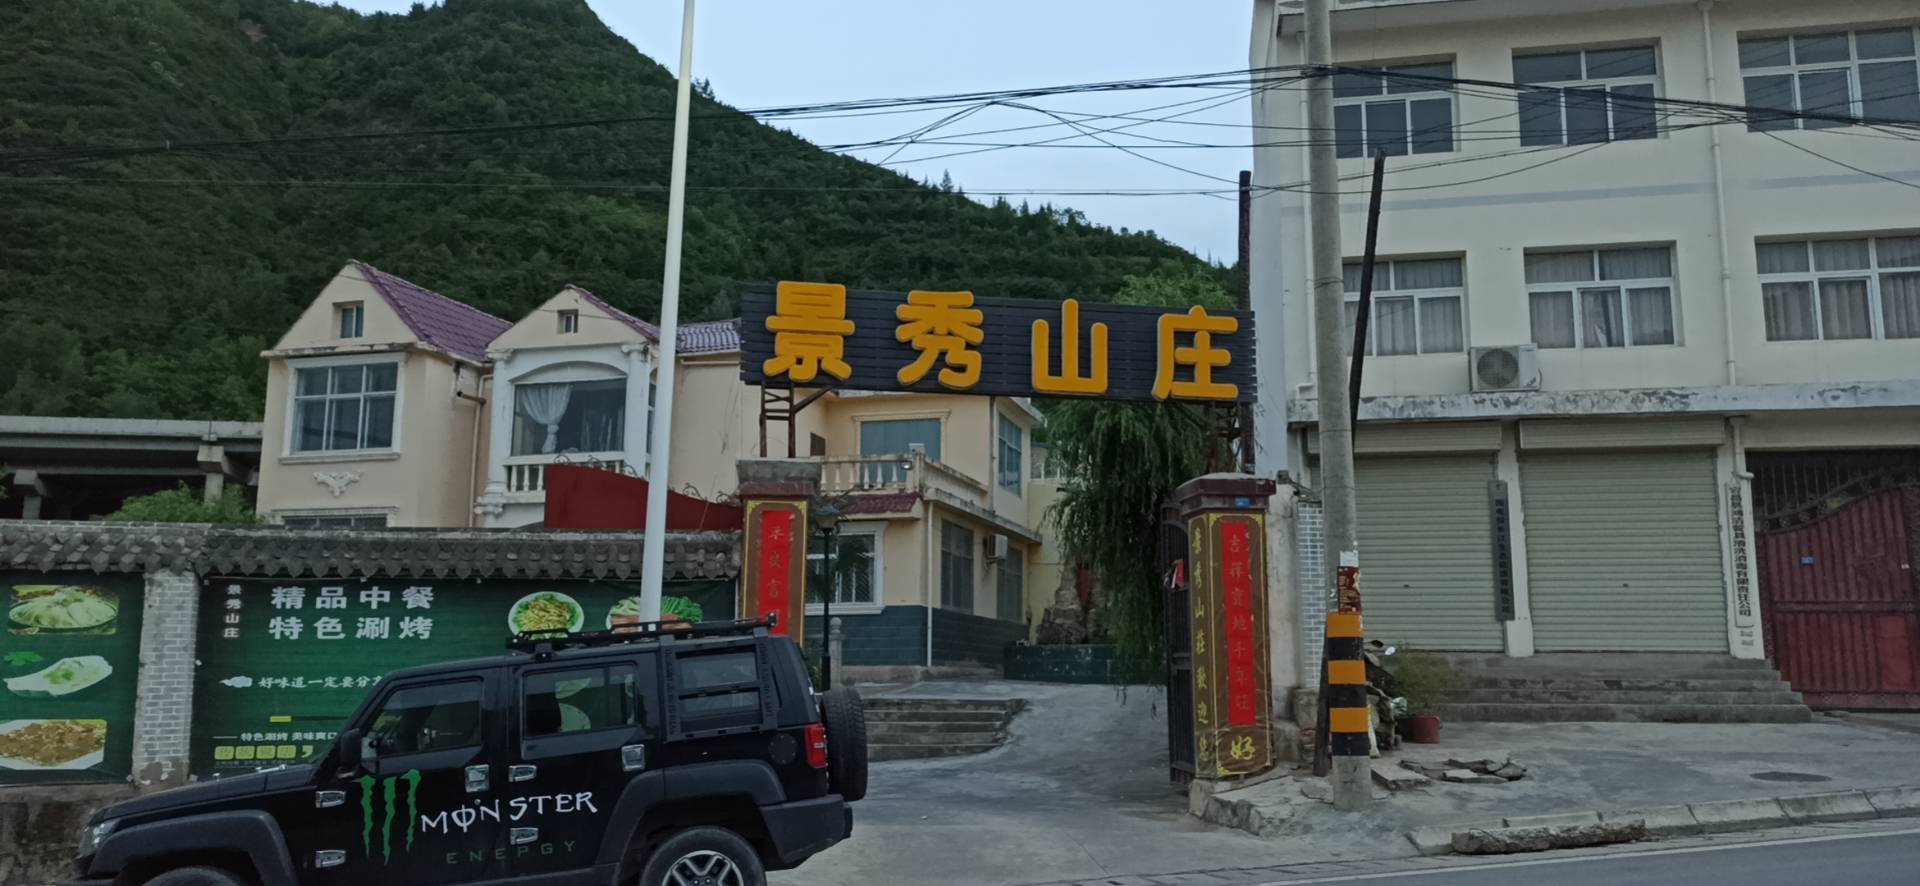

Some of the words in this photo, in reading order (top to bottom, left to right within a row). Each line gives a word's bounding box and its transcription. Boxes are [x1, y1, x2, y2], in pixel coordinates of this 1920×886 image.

[762, 280, 1239, 401] 景秀山庄
[223, 584, 243, 640] 景秀山庄
[270, 586, 435, 610] 精品中餐
[268, 616, 435, 641] 特色涮烤
[1230, 735, 1256, 761] 好
[421, 791, 598, 835] MONSTER
